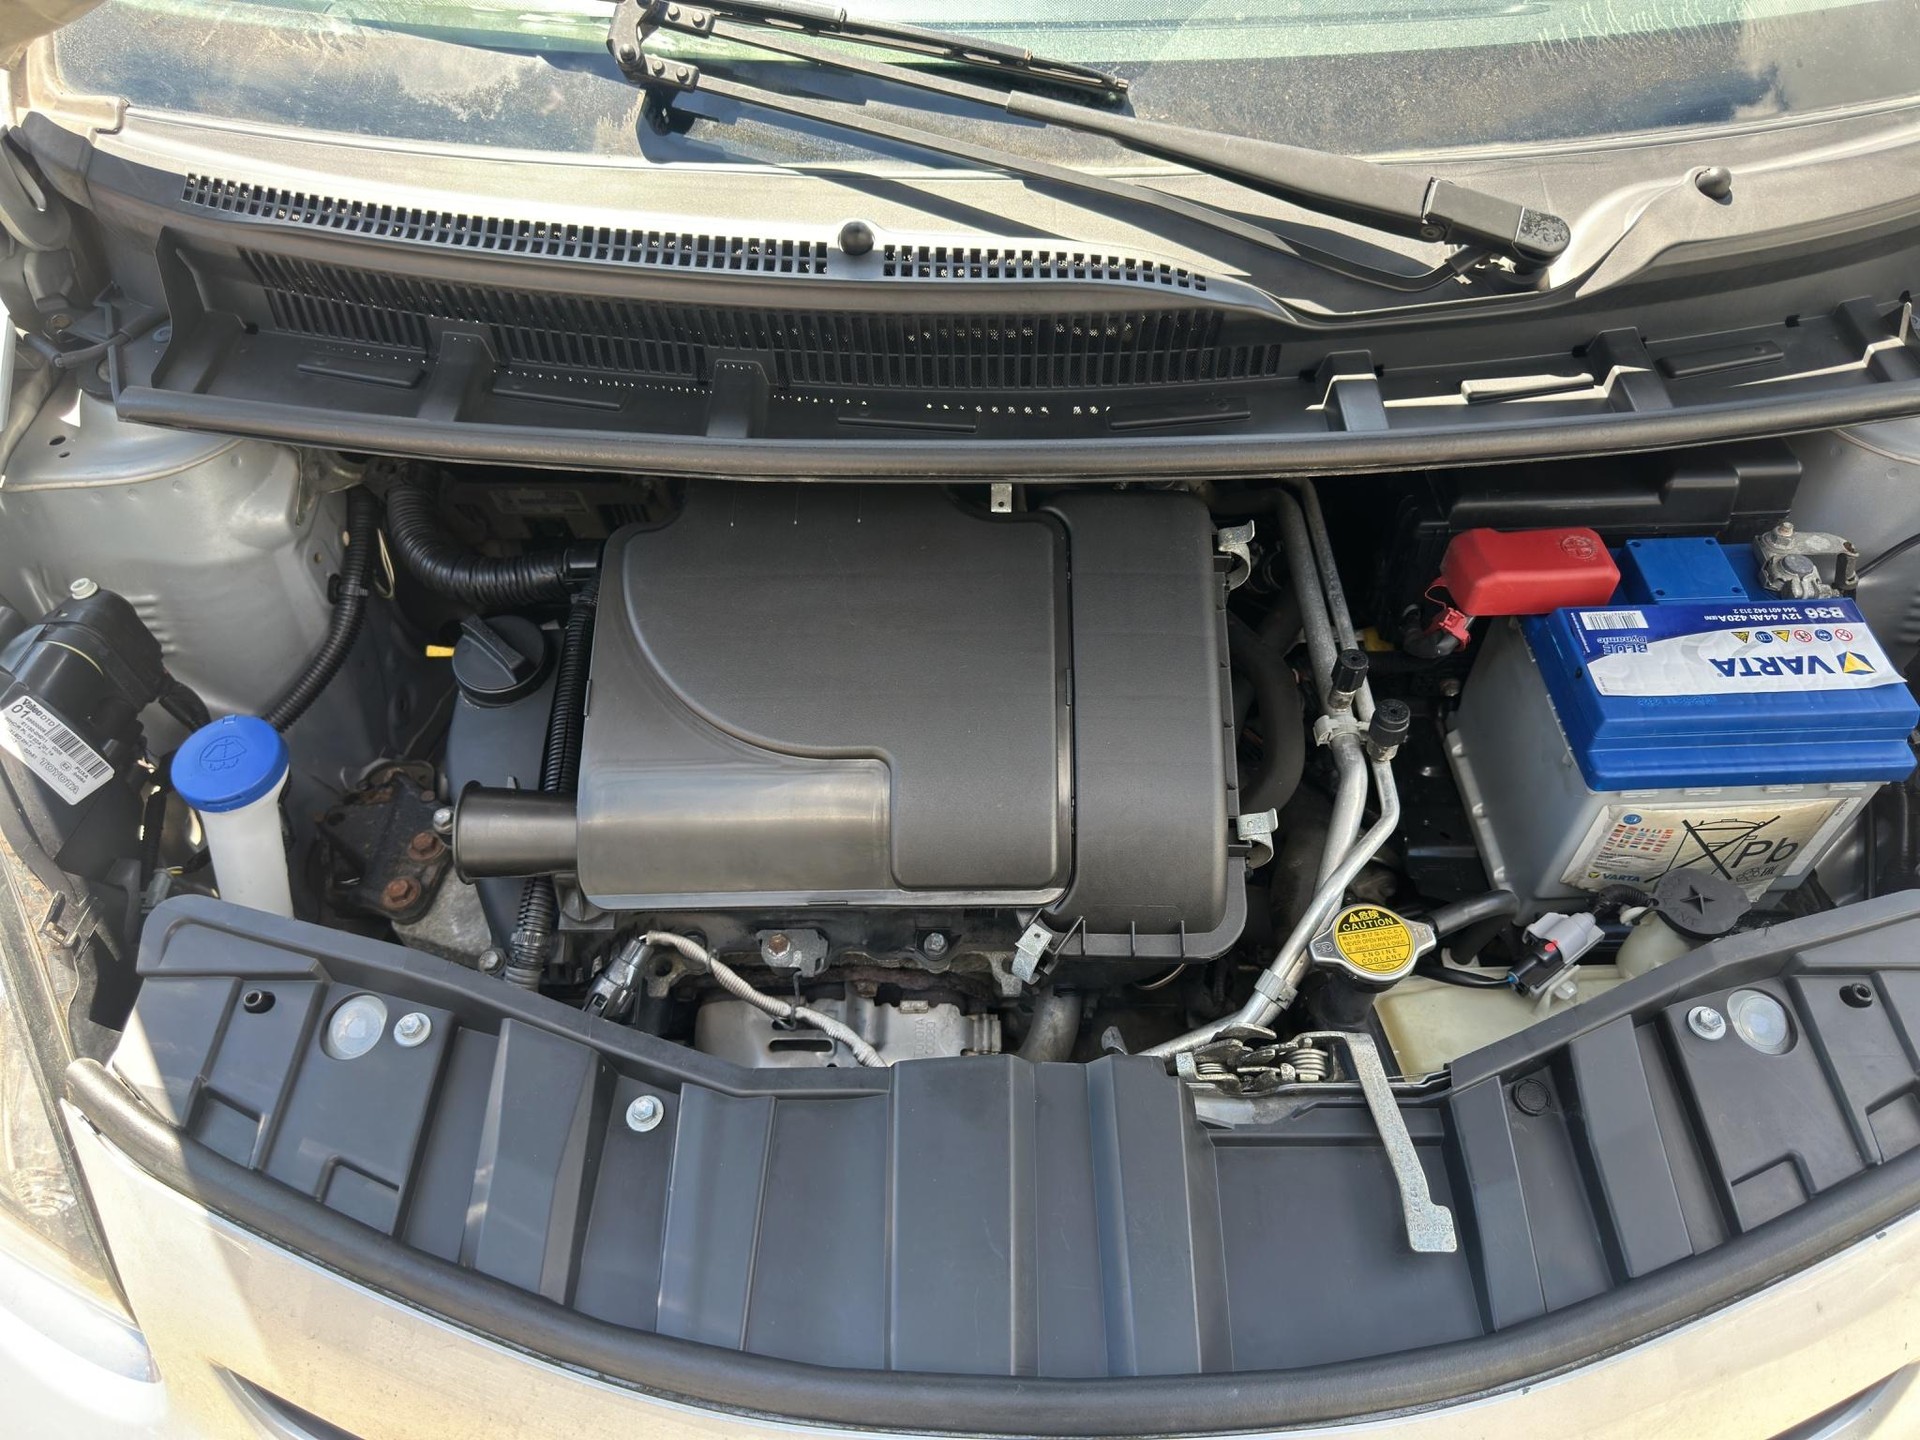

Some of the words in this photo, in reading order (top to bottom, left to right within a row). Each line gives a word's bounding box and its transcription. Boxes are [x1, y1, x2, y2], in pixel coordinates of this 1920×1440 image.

[1750, 613, 1779, 621] 44Ah
[1781, 612, 1803, 620] 12V
[1804, 606, 1846, 620] B36
[1596, 633, 1648, 645] Dynamic
[1602, 643, 1649, 655] BLUE
[1708, 655, 1837, 678] VARTA
[11, 704, 29, 719] 01
[22, 698, 43, 717] Valeo
[39, 757, 80, 795] TOYOTA
[1731, 837, 1799, 869] Pb
[1602, 872, 1641, 883] VARTA
[1358, 909, 1380, 921] 危険
[1342, 917, 1394, 931] CAUTION
[1361, 954, 1403, 963] COOLANT
[1362, 949, 1398, 958] ENGINE
